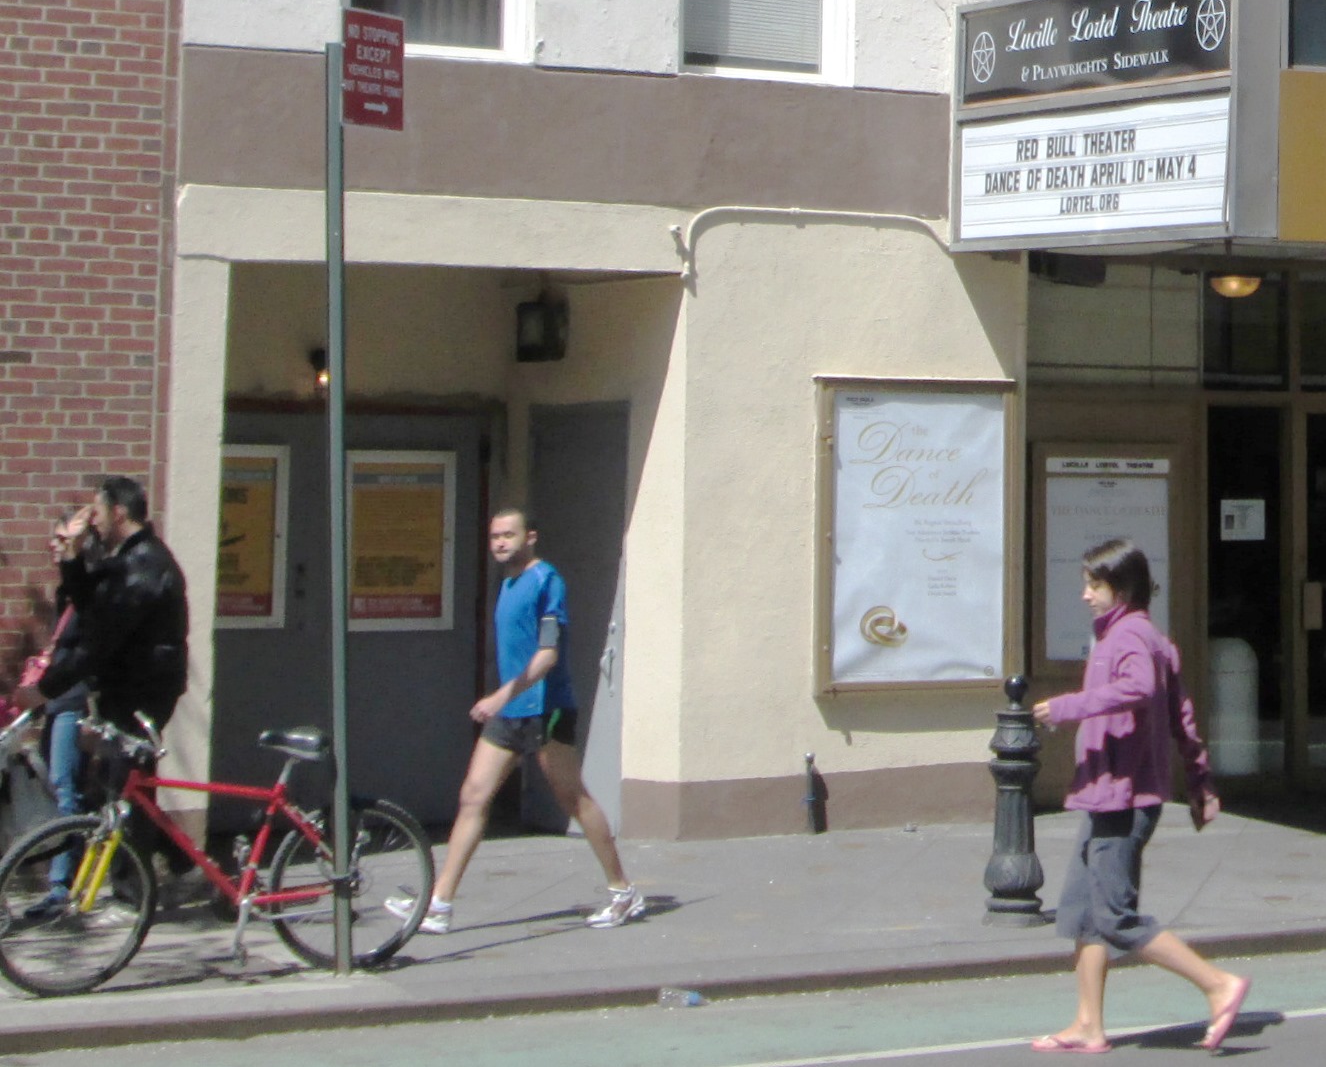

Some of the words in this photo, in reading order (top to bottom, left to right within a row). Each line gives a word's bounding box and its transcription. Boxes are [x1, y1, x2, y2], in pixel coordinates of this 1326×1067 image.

[1005, 18, 1058, 53] Lucille
[1068, 6, 1119, 43] Lortel
[356, 45, 392, 64] EXCEPT
[1021, 67, 1031, 82] &
[1033, 60, 1108, 82] PLAYWRIGHTS
[1113, 49, 1169, 71] SIDEWALK
[1016, 137, 1039, 163] RED
[1046, 133, 1076, 159] BULL
[1084, 129, 1136, 157] THEATER
[985, 169, 1020, 195] DANCE
[1027, 168, 1042, 191] OF
[1046, 163, 1085, 189] DEATH
[1090, 160, 1127, 187] APRIL
[1188, 154, 1197, 178] 4
[1059, 193, 1120, 216] LORTEL.ORG
[848, 420, 963, 465] Dance
[862, 466, 989, 510] Death
